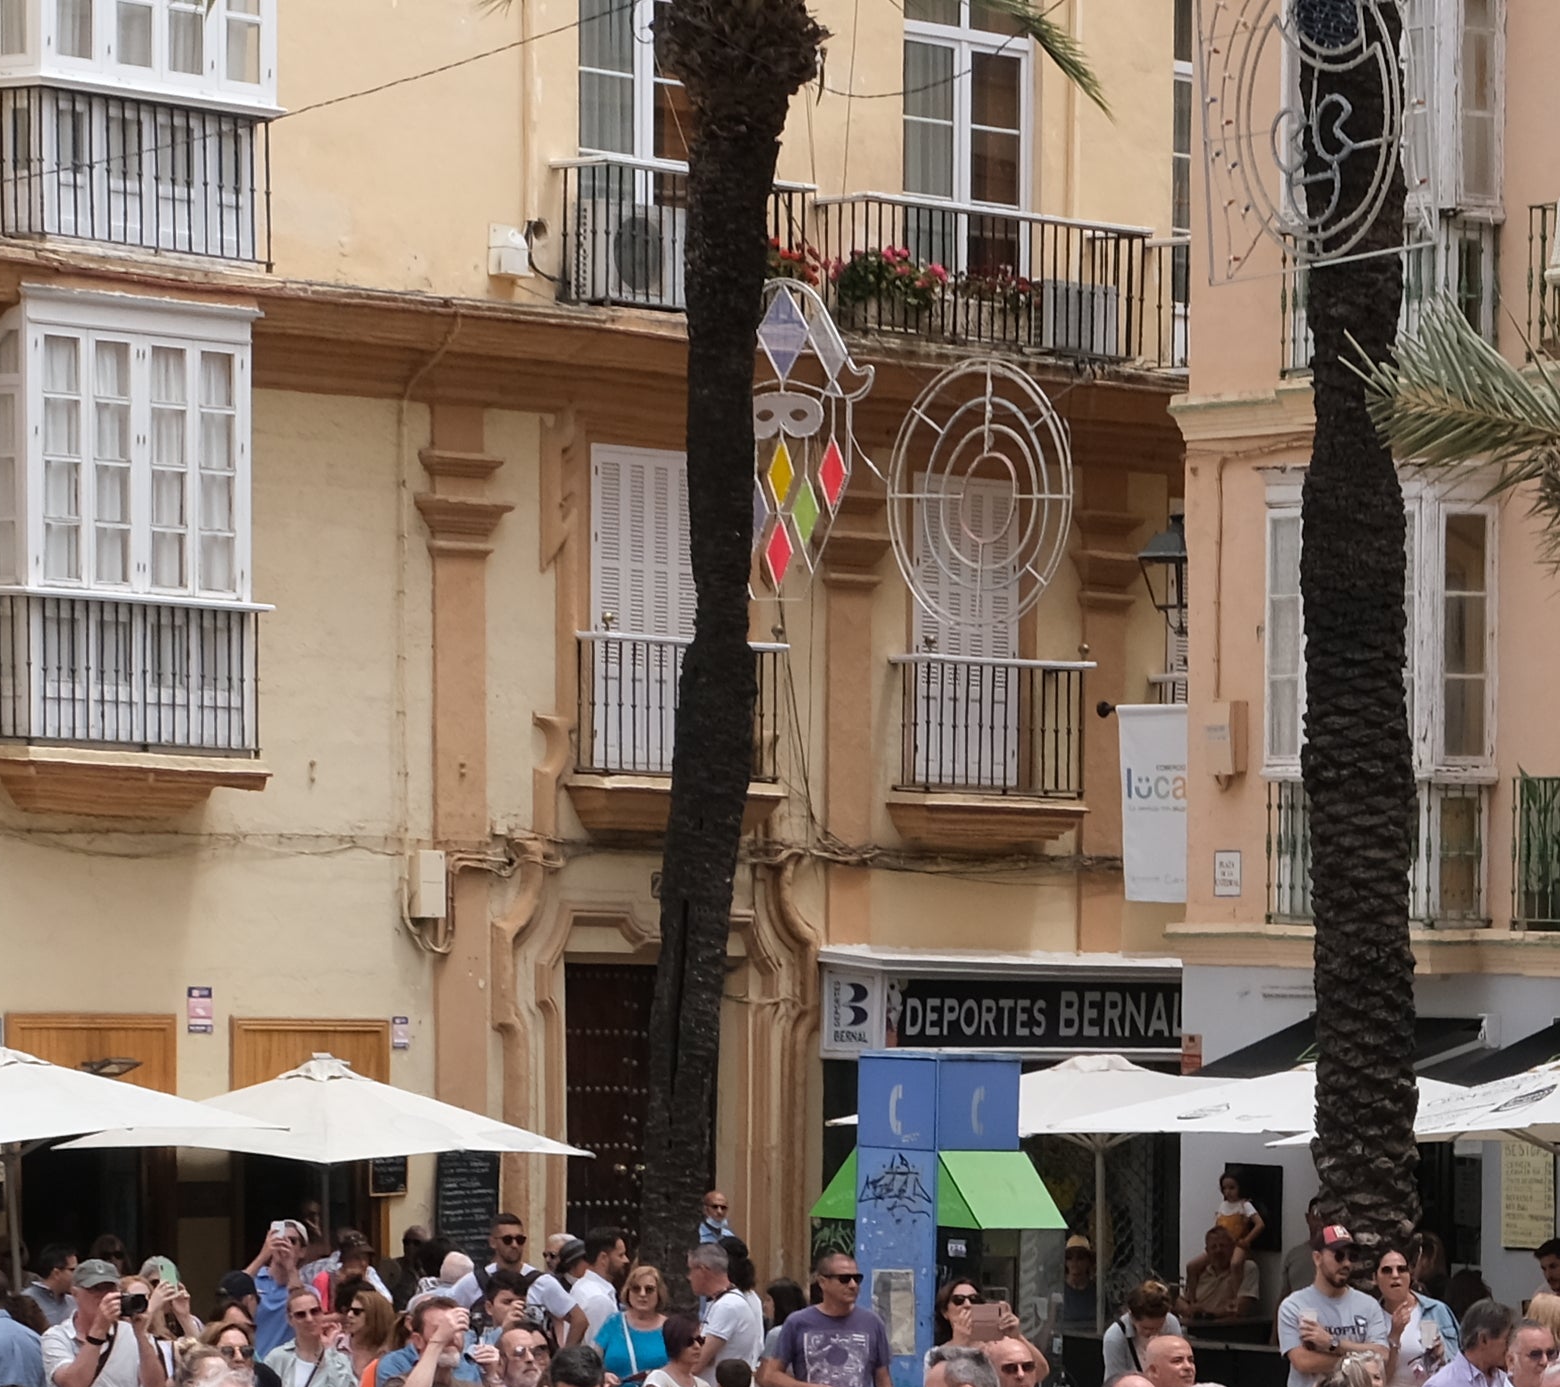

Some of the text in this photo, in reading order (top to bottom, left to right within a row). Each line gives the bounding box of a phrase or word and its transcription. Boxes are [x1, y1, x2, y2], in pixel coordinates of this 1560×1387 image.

[905, 990, 1183, 1038] DEPORTES BERNAL
[834, 1030, 868, 1043] BERNAL
